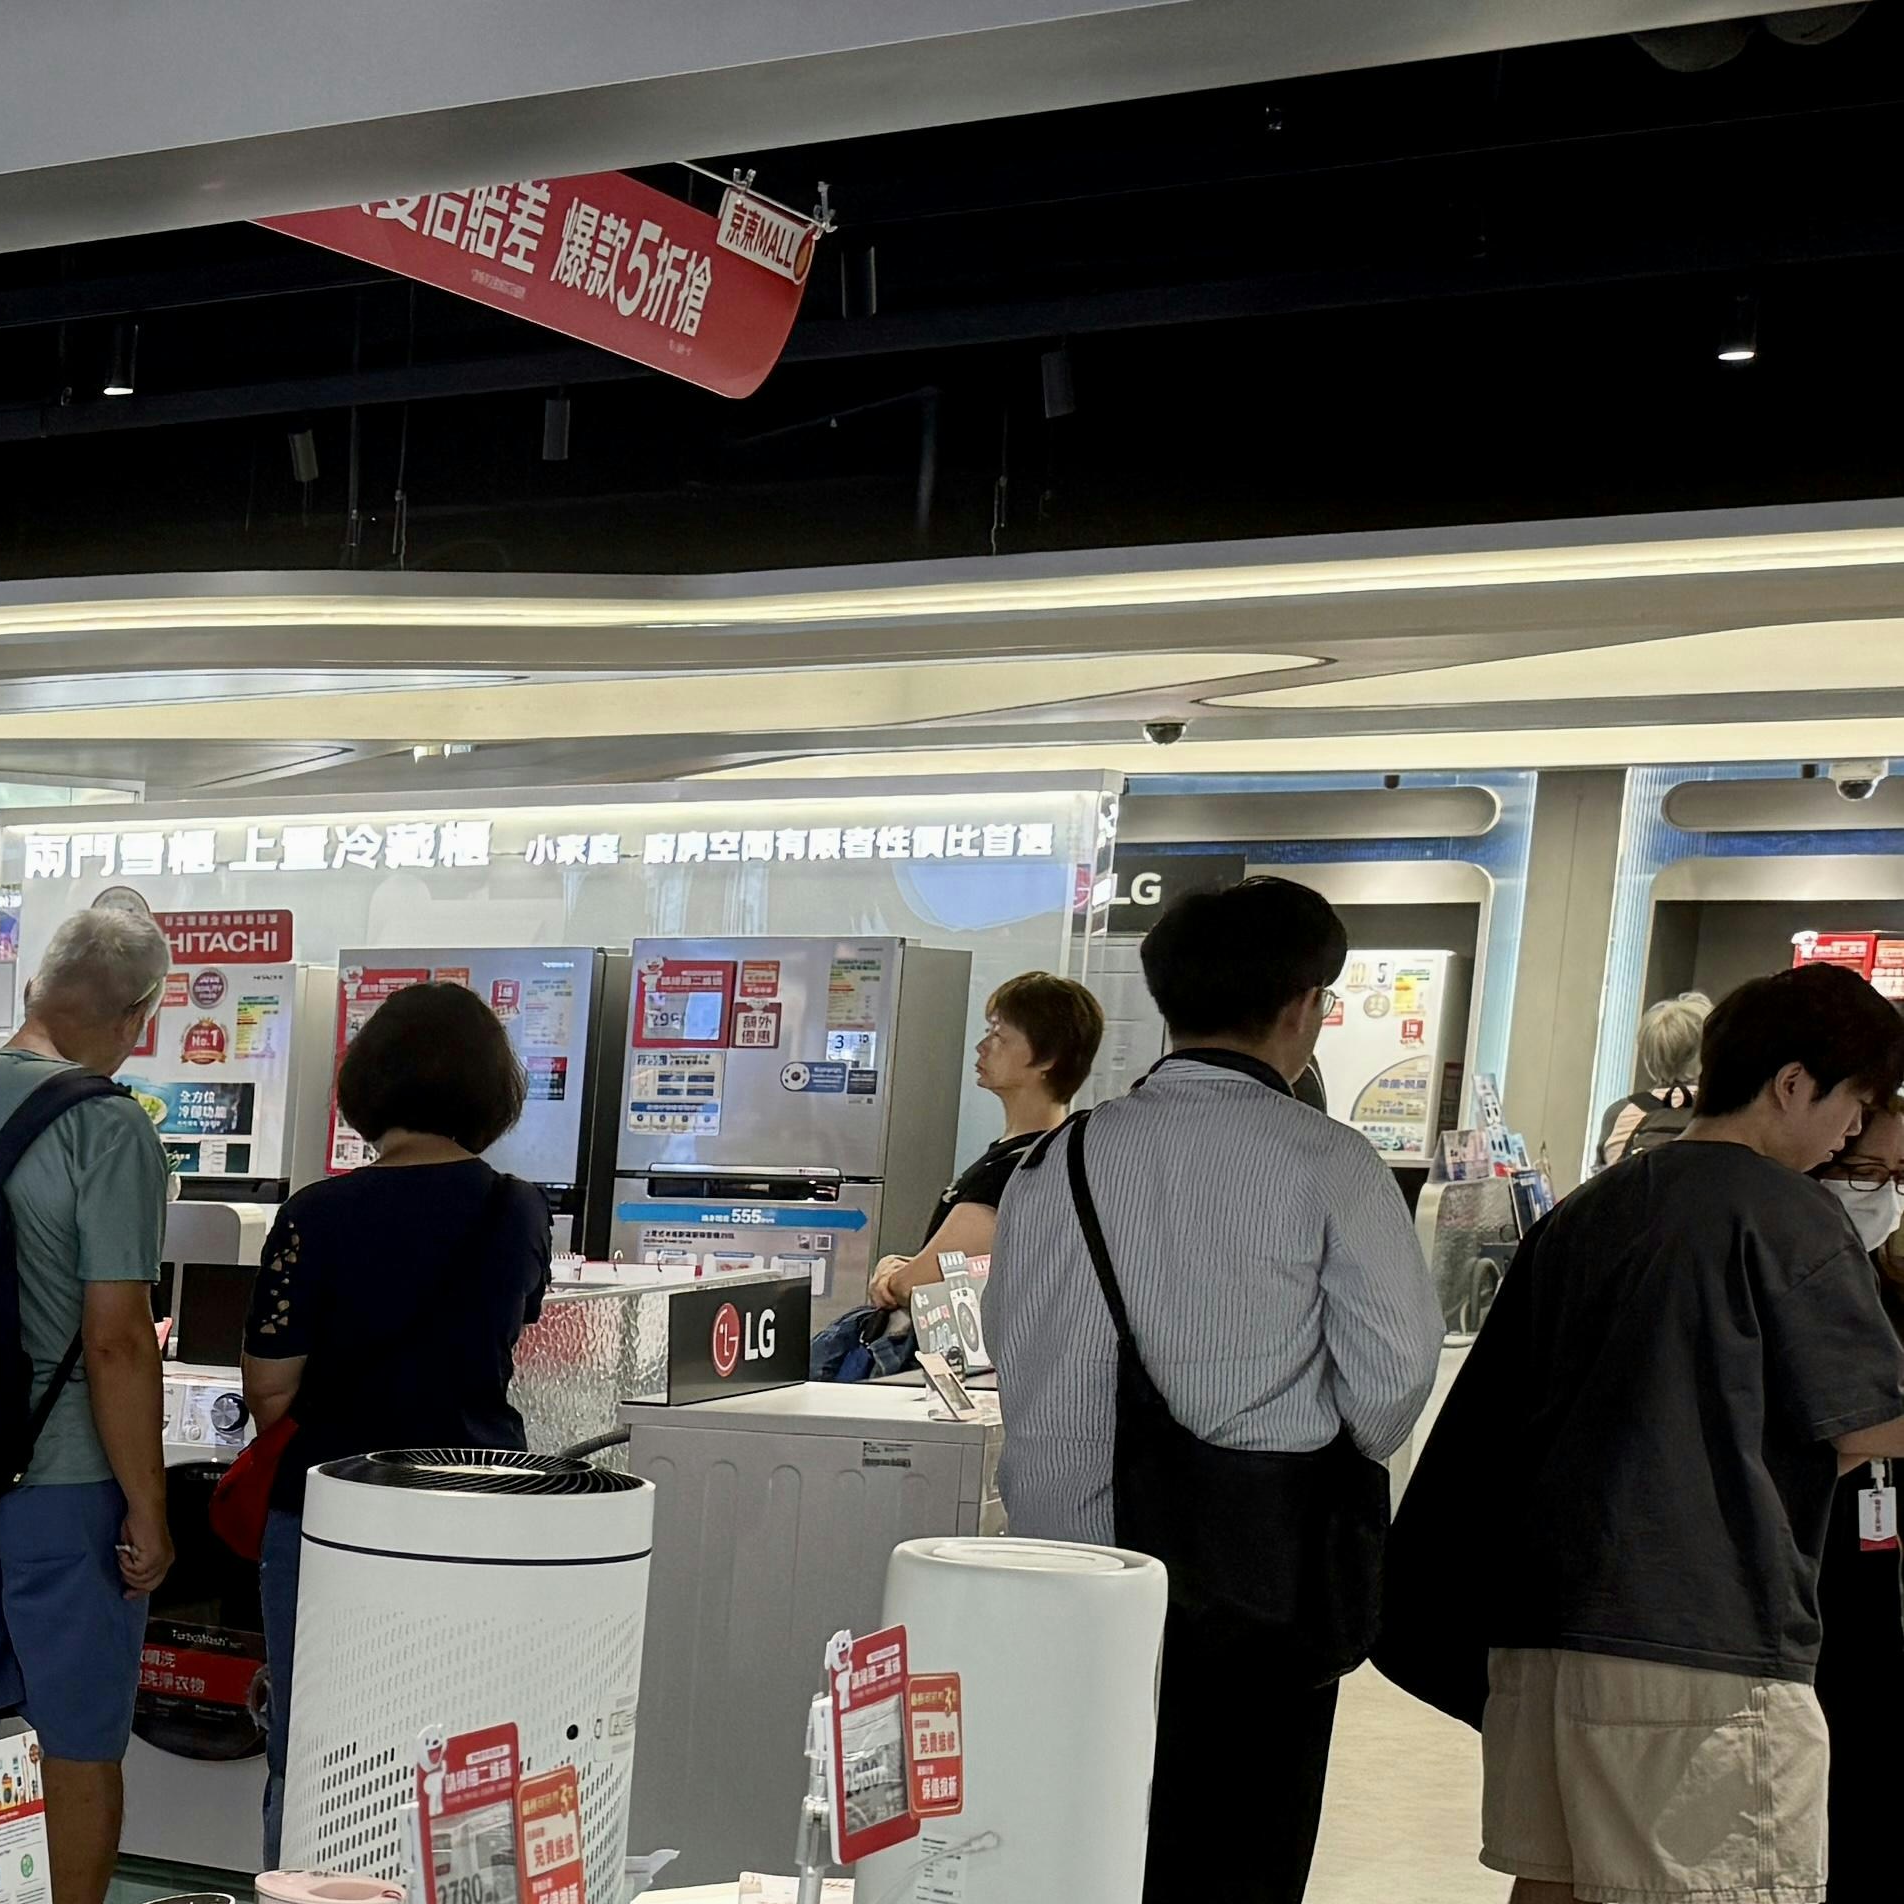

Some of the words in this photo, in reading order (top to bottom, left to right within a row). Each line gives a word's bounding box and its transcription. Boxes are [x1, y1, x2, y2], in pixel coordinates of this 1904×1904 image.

[550, 196, 712, 337] 爆款5折搶
[166, 930, 278, 953] HITACHI
[743, 1307, 777, 1362] LG
